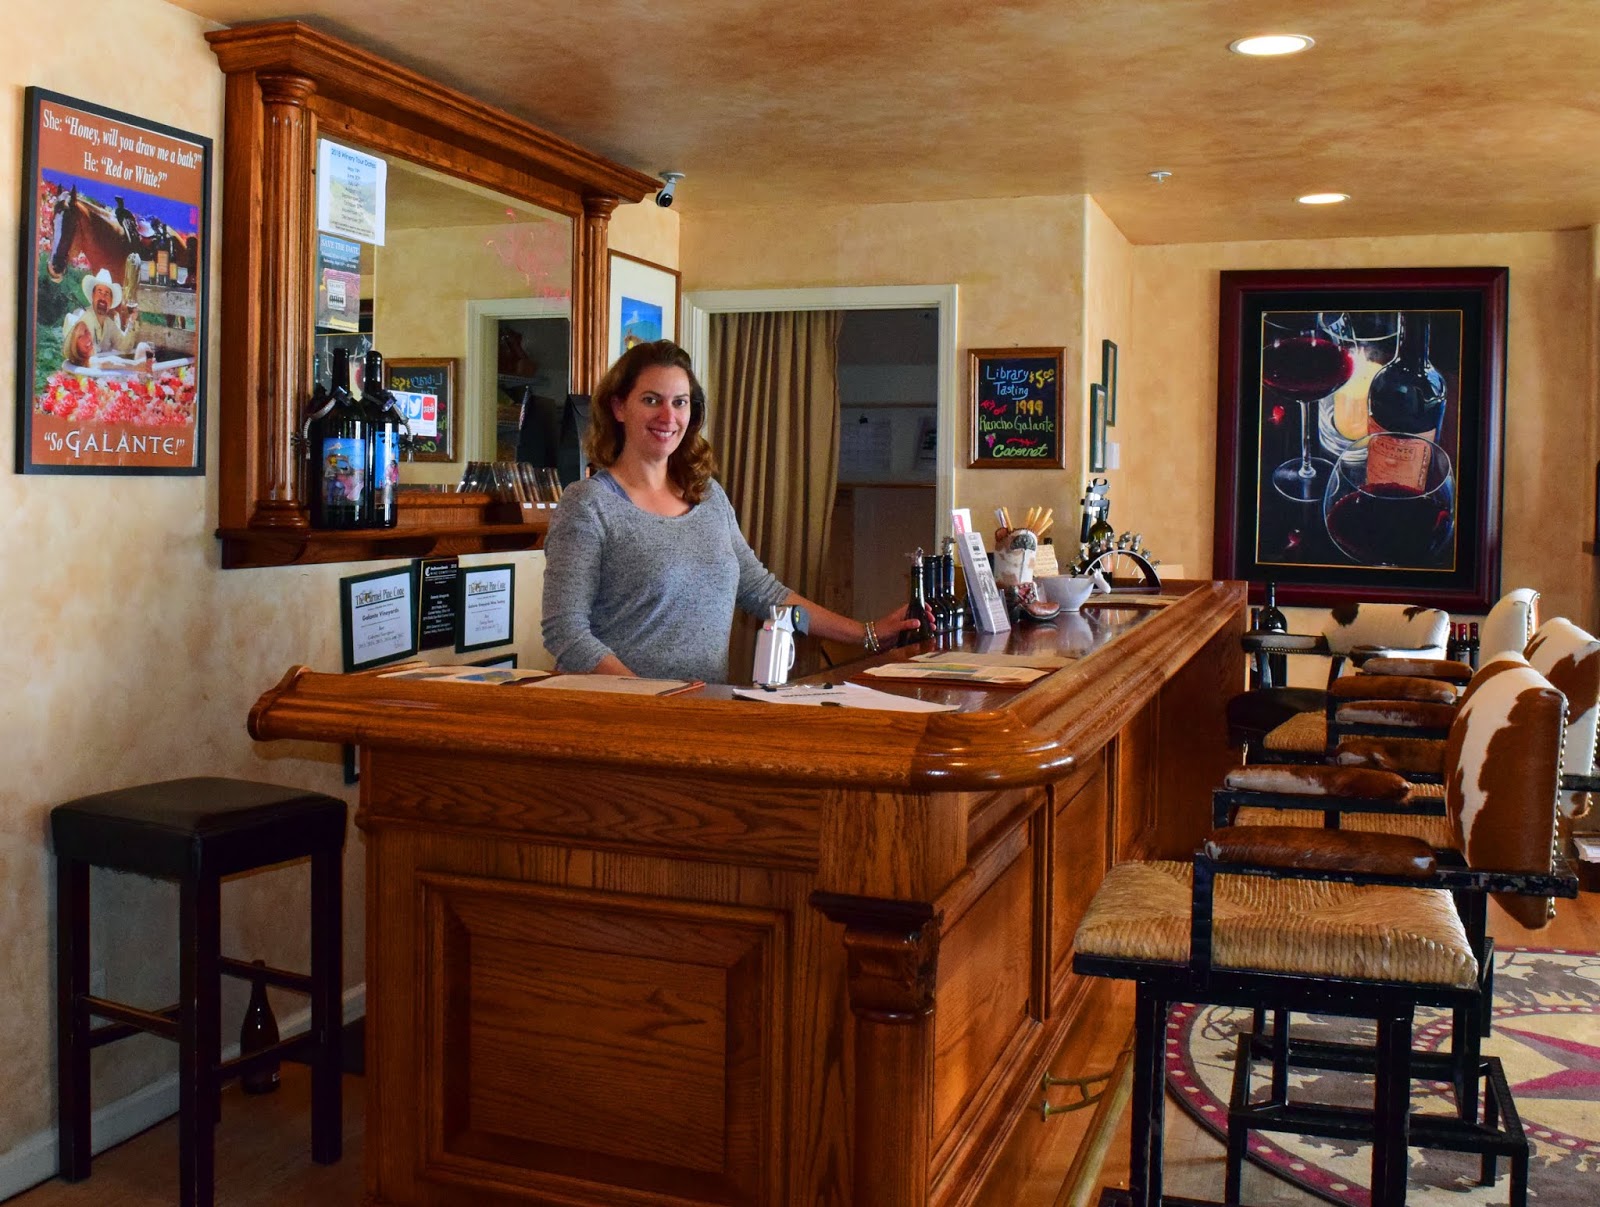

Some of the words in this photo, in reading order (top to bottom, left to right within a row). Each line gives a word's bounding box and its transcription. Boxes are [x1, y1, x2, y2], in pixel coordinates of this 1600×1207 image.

[43, 108, 62, 131] She:
[103, 128, 118, 147] will
[118, 136, 134, 153] you
[135, 136, 156, 157] draw
[157, 147, 169, 161] me
[170, 151, 176, 164] a
[84, 151, 99, 172] He:
[101, 156, 123, 178] “Red
[123, 167, 134, 181] or
[986, 365, 1029, 384] Library
[992, 380, 1029, 400] Tasting
[1015, 399, 1044, 416] 1999
[979, 414, 1013, 432] Rancho
[1014, 414, 1054, 434] Galante
[992, 443, 1048, 458] Cabernet
